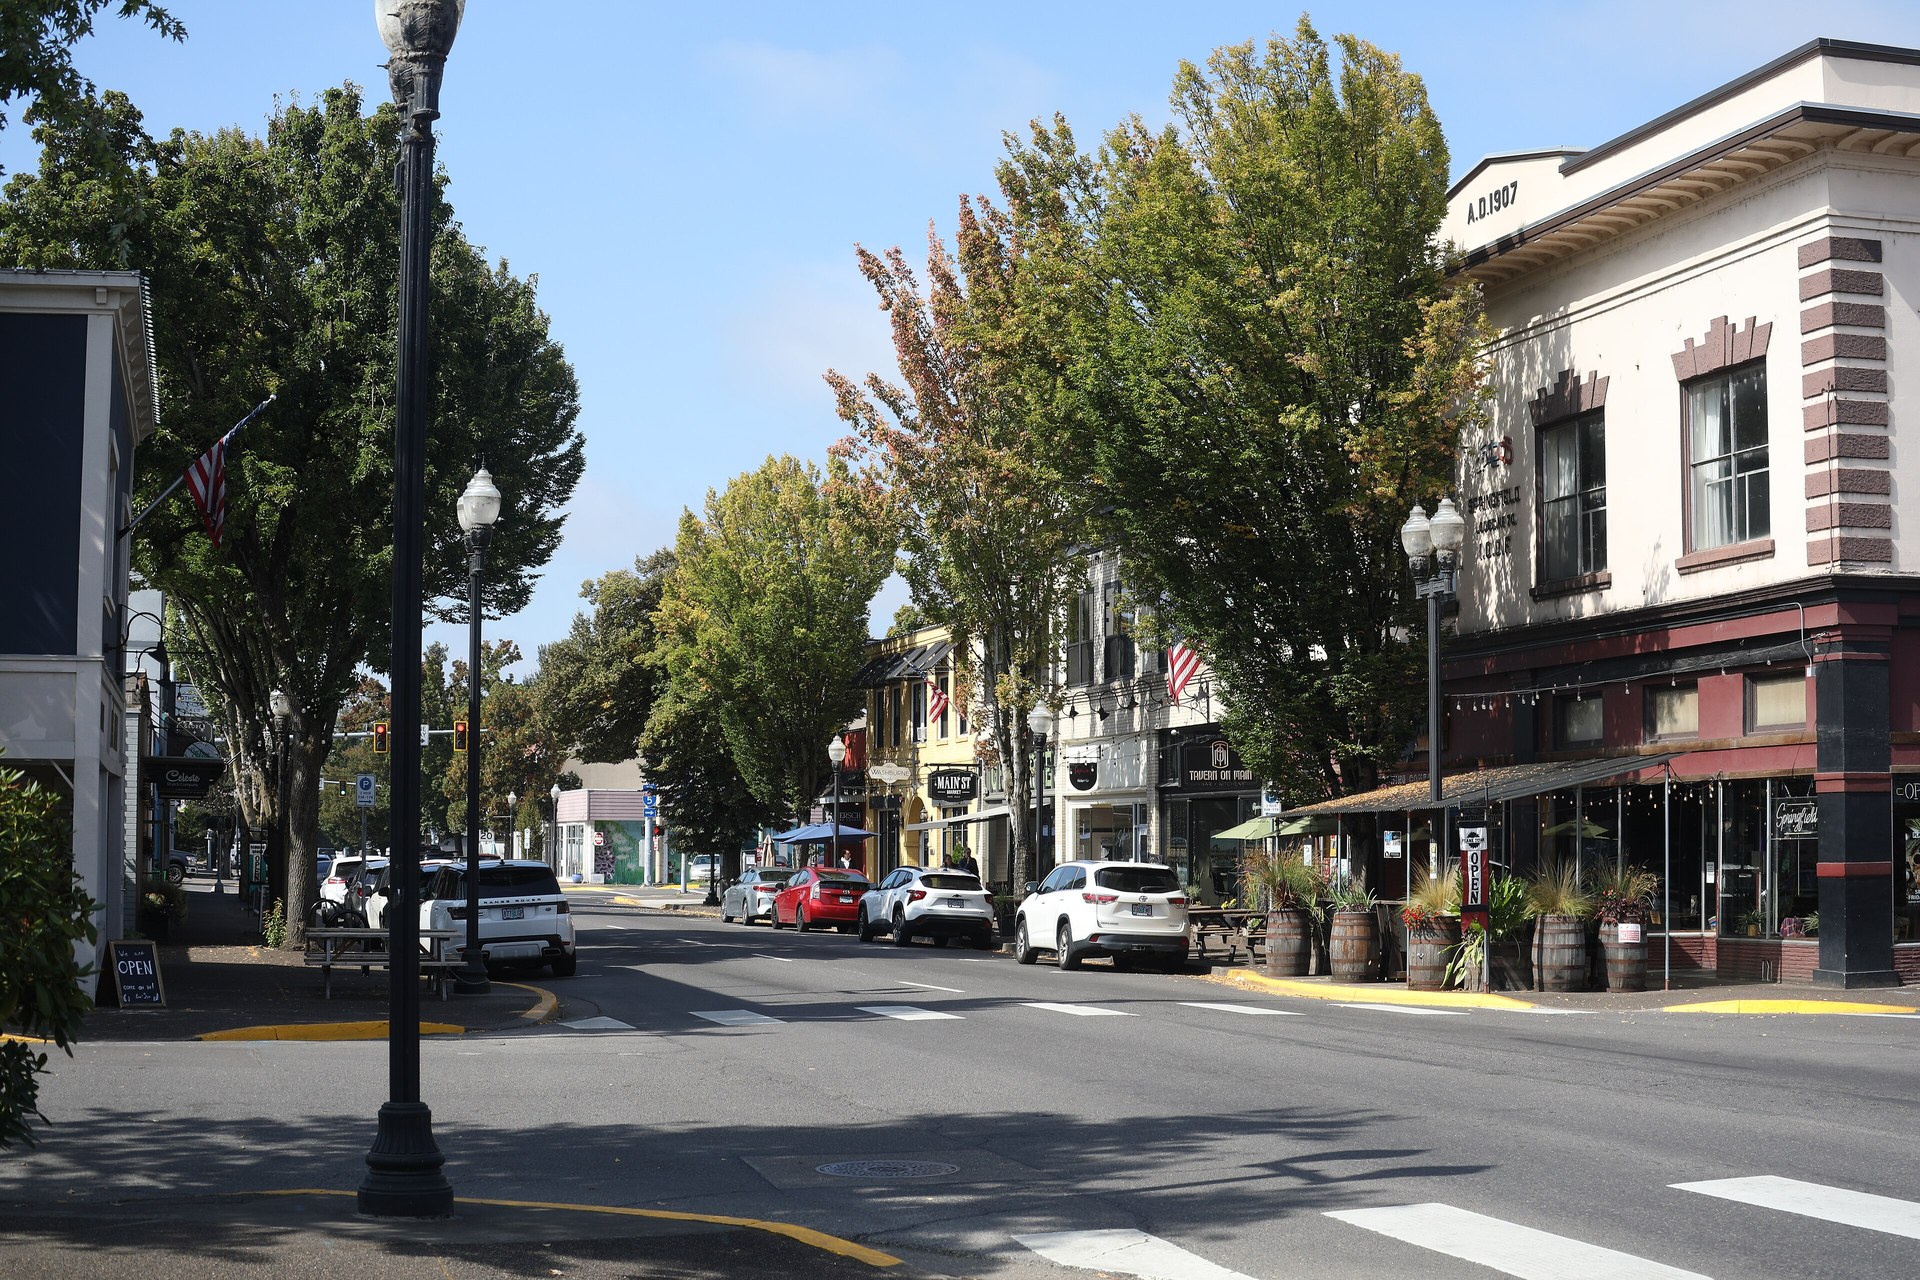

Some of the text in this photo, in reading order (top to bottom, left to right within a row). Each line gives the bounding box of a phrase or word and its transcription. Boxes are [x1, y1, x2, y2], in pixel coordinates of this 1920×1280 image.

[166, 769, 201, 783] Celeste
[871, 769, 910, 777] WASHBURNE
[1189, 770, 1253, 781] TAVERN ON MAIN
[937, 776, 971, 790] MAIN ST
[647, 796, 653, 805] 5
[1776, 803, 1818, 832] Springfield
[480, 832, 493, 840] 20
[1470, 852, 1479, 904] OPEN
[118, 960, 153, 976] OPEN
